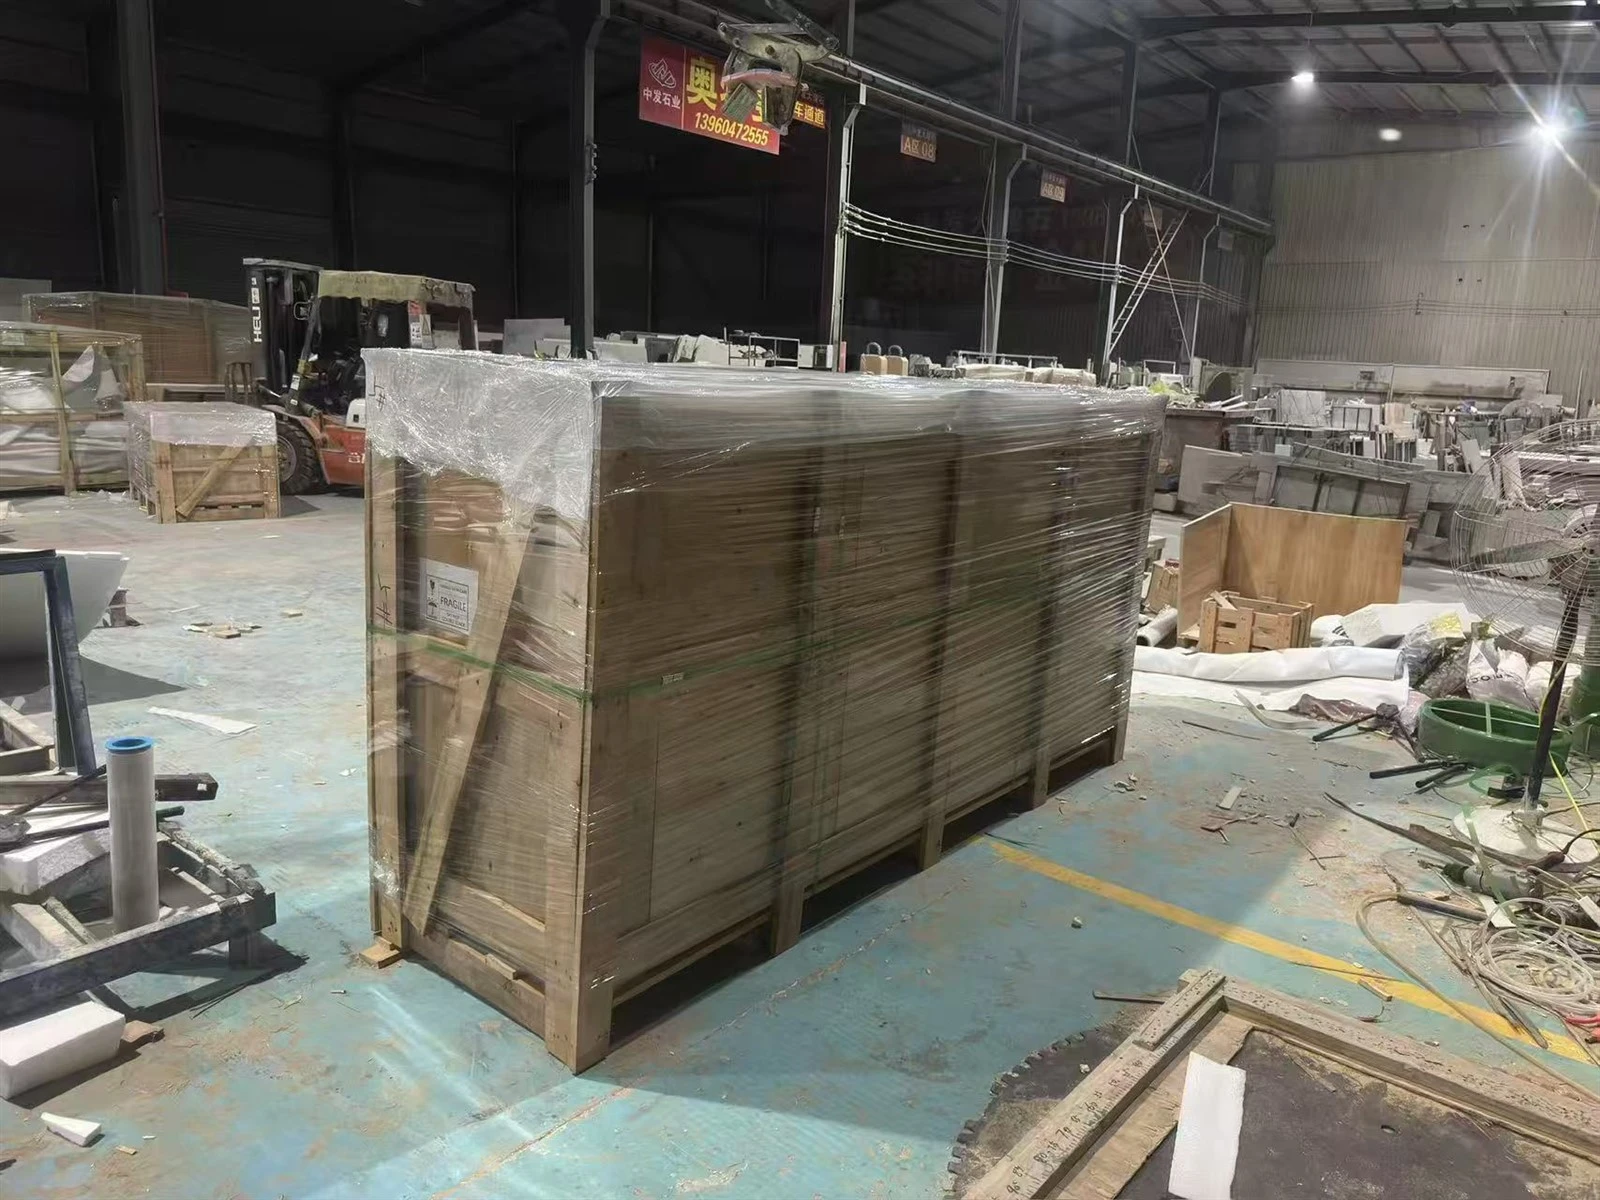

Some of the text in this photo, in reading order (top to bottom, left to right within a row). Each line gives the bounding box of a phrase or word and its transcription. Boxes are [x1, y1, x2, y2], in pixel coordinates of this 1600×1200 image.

[643, 86, 681, 110] 中发石业
[695, 112, 769, 146] 13960472555
[440, 596, 467, 613] FRAGILE
